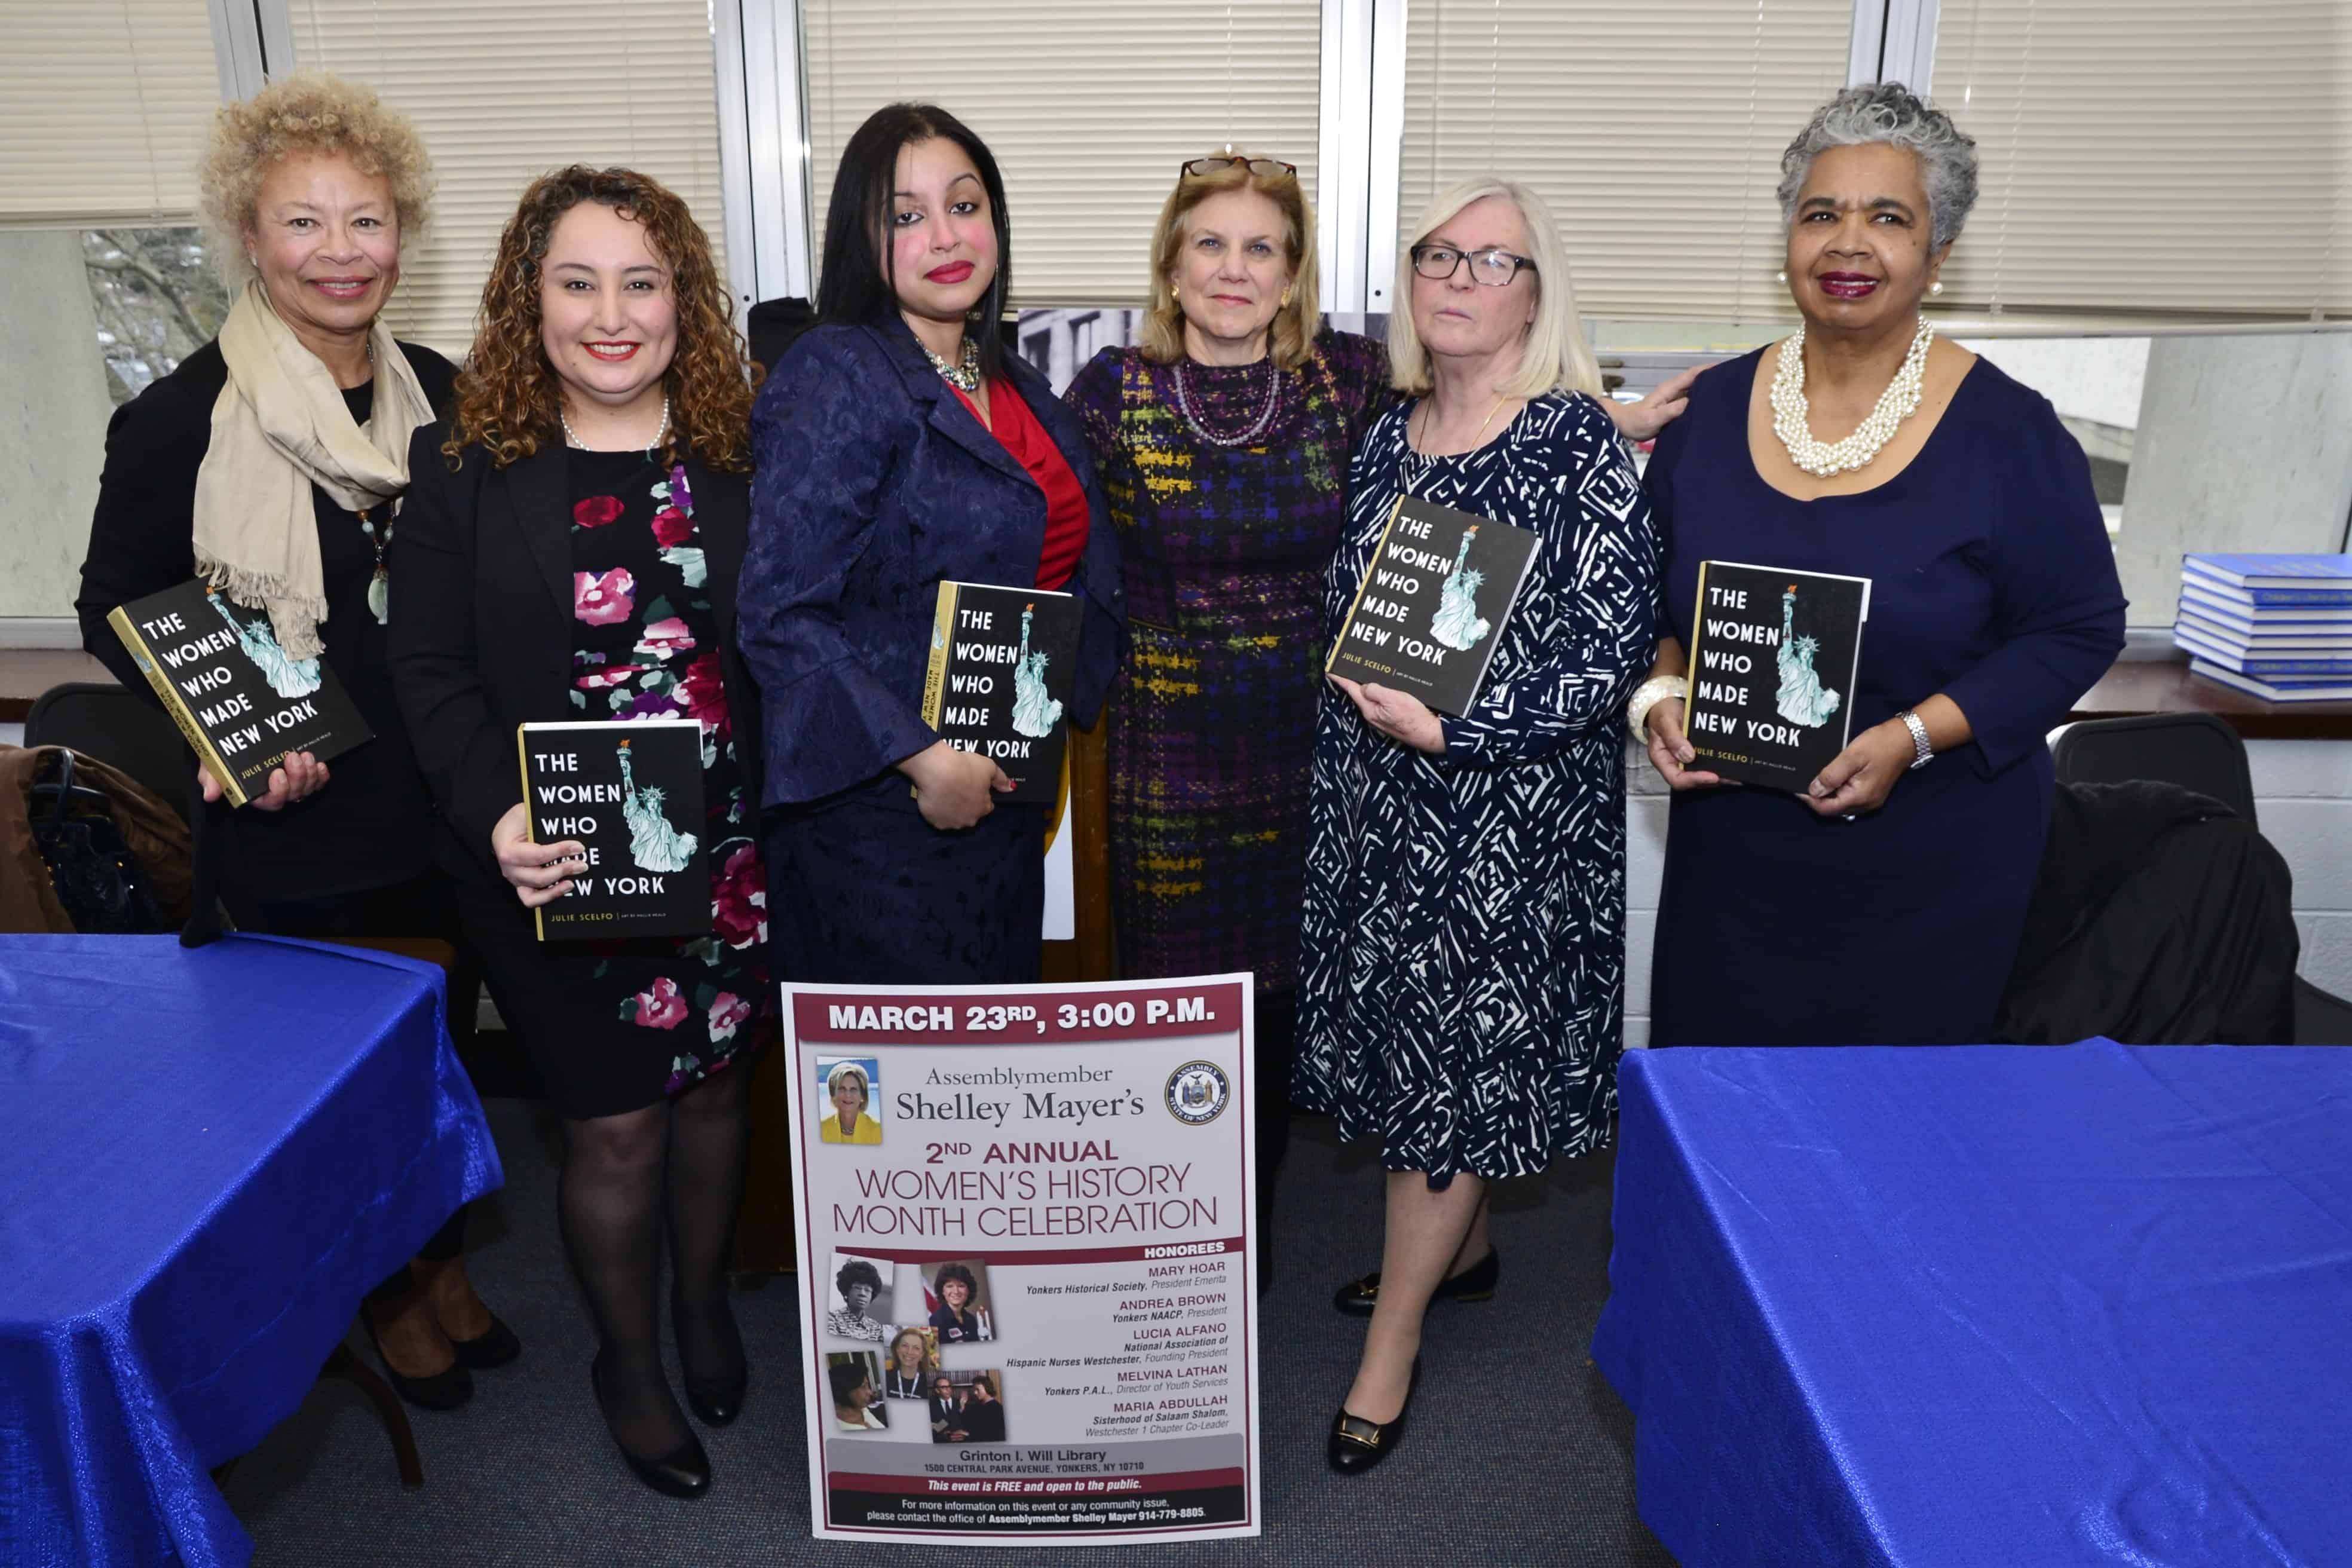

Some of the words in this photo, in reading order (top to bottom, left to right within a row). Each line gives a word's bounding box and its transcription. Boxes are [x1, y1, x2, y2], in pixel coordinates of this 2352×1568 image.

[1399, 516, 1433, 540] THE
[1388, 542, 1452, 575] WOMEN
[1376, 569, 1419, 595] WHO
[1710, 587, 1748, 610] THE
[1362, 595, 1410, 623] MADE
[142, 612, 186, 640] THE
[960, 610, 993, 630] THE
[1707, 618, 1780, 646] WOMEN
[162, 629, 237, 669] WOMEN
[956, 642, 1018, 664] WOMEN
[1350, 621, 1392, 647] NEW
[1397, 635, 1447, 666] YORK
[1342, 652, 1362, 664] JULIE
[1364, 659, 1392, 673] SCELFO
[1704, 650, 1751, 674] WHO
[182, 666, 232, 697] WHO
[951, 675, 993, 694] WHO
[1698, 681, 1749, 706] MADE
[200, 693, 252, 727] MADE
[945, 707, 989, 726] MADE
[219, 724, 261, 755] NEW
[264, 699, 318, 734] YORK
[1695, 712, 1737, 735] NEW
[1747, 719, 1802, 747] YORK
[987, 740, 1031, 758] YORK
[1717, 751, 1748, 763] SCELFO
[241, 764, 262, 779] JULIE
[535, 753, 578, 772] THE
[538, 784, 621, 804] WOMEN
[541, 817, 597, 835] WHO
[604, 877, 664, 895] YORK
[551, 914, 574, 922] JULIE
[579, 912, 613, 921] SCELFO
[829, 1004, 953, 1031] MARCH
[966, 1005, 1045, 1034] 23RD,
[1057, 1002, 1135, 1029] 3:00
[1146, 997, 1215, 1024] P.M.
[926, 1065, 1113, 1089] Assemblymember
[896, 1091, 1010, 1127] Shelley
[1022, 1088, 1144, 1127] Mayer's
[926, 1143, 972, 1164] 2ND
[983, 1140, 1119, 1163] ANNUAL
[856, 1169, 1036, 1200] WOMEN'S
[1049, 1162, 1191, 1199] HISTORY
[834, 1204, 964, 1236] MONTH
[978, 1196, 1217, 1236] CELEBRATION
[1144, 1241, 1225, 1258] HONOREES
[1149, 1265, 1185, 1277] MARY
[1190, 1261, 1225, 1273] HOAR
[1027, 1285, 1062, 1295] Yonkers
[1065, 1283, 1109, 1293] Historical
[1112, 1282, 1147, 1293] Society,
[1152, 1278, 1192, 1289] President
[1195, 1275, 1226, 1285] Emerita
[1120, 1298, 1174, 1310] ANDREA
[1178, 1293, 1226, 1306] BROWN
[1113, 1313, 1147, 1324] Yonkers
[1187, 1305, 1227, 1318] President
[1134, 1328, 1171, 1340] LUCIA
[1176, 1322, 1226, 1337] ALFANO
[1125, 1342, 1162, 1352] National
[1165, 1337, 1216, 1349] Association
[1219, 1335, 1228, 1345] of
[1007, 1358, 1046, 1368] Hispanic
[1049, 1358, 1080, 1367] Nurses
[1084, 1355, 1142, 1366] Westchester,
[1145, 1352, 1185, 1363] Founding
[1189, 1348, 1227, 1359] President
[1117, 1370, 1172, 1382] MELVINA
[1177, 1365, 1227, 1378] LATHAN
[1045, 1387, 1079, 1396] Yonkers
[1117, 1384, 1151, 1394] Director
[1154, 1383, 1163, 1392] of
[1166, 1381, 1190, 1391] Youth
[1192, 1377, 1228, 1389] Services
[1114, 1401, 1154, 1413] MARIA
[1159, 1395, 1227, 1410] ABDULLAH
[1086, 1426, 1139, 1437] Westchester
[1150, 1423, 1183, 1435] Chapter
[1186, 1419, 1229, 1431] Co-Leader
[1093, 1415, 1141, 1425] Sisterhood
[1144, 1414, 1153, 1423] of
[1156, 1411, 1189, 1422] Salaam
[960, 1450, 1010, 1462] Grinton
[1016, 1451, 1023, 1462] I.
[1028, 1450, 1052, 1461] Will
[1058, 1450, 1106, 1463] Library
[947, 1465, 986, 1473] CENTRAL
[990, 1465, 1013, 1473] PARK
[1016, 1464, 1053, 1473] AVENUE,
[1056, 1464, 1100, 1473] YONKERS,
[1104, 1463, 1115, 1471] NY
[929, 1480, 948, 1491] This
[951, 1481, 979, 1492] event
[982, 1481, 992, 1492] is
[994, 1481, 1021, 1492] FREE
[1024, 1482, 1043, 1492] and
[1046, 1483, 1071, 1493] open
[1075, 1481, 1085, 1491] to
[1088, 1481, 1104, 1490] the
[1107, 1479, 1141, 1492] public.
[902, 1499, 916, 1509] For
[945, 1500, 996, 1511] information
[1012, 1502, 1030, 1511] this
[1032, 1502, 1056, 1511] event
[1059, 1502, 1069, 1511] or
[1071, 1502, 1086, 1512] any
[1089, 1499, 1140, 1510] community
[867, 1510, 895, 1522] please
[898, 1512, 930, 1522] contact
[933, 1513, 947, 1523] the
[949, 1513, 974, 1523] office
[976, 1514, 986, 1523] of
[989, 1514, 1070, 1525] Assemblymember
[1073, 1512, 1106, 1524] Shelley
[1108, 1512, 1137, 1524] Mayer
